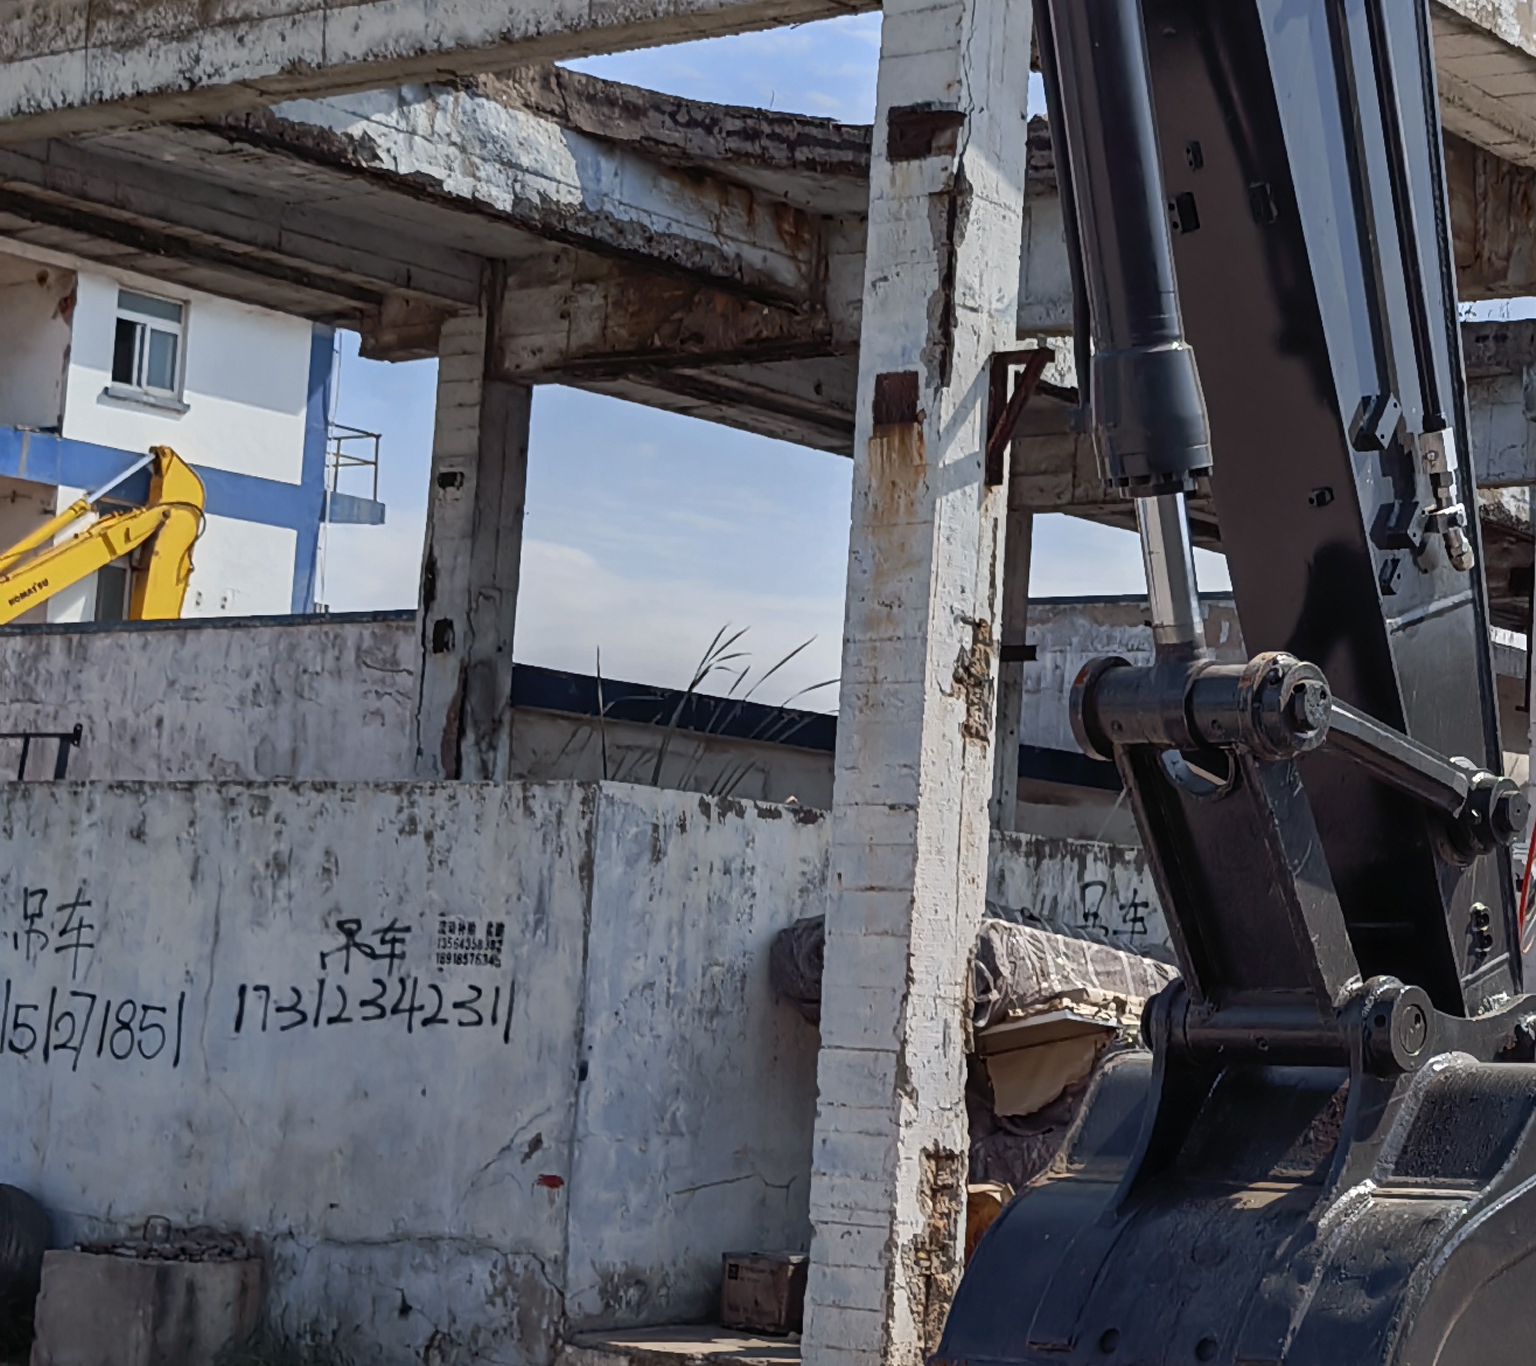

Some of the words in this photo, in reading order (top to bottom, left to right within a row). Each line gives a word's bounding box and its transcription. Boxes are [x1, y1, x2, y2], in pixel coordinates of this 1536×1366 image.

[13, 886, 94, 980] 吊车
[319, 918, 412, 976] 吊车
[234, 976, 516, 1044] 17312342311
